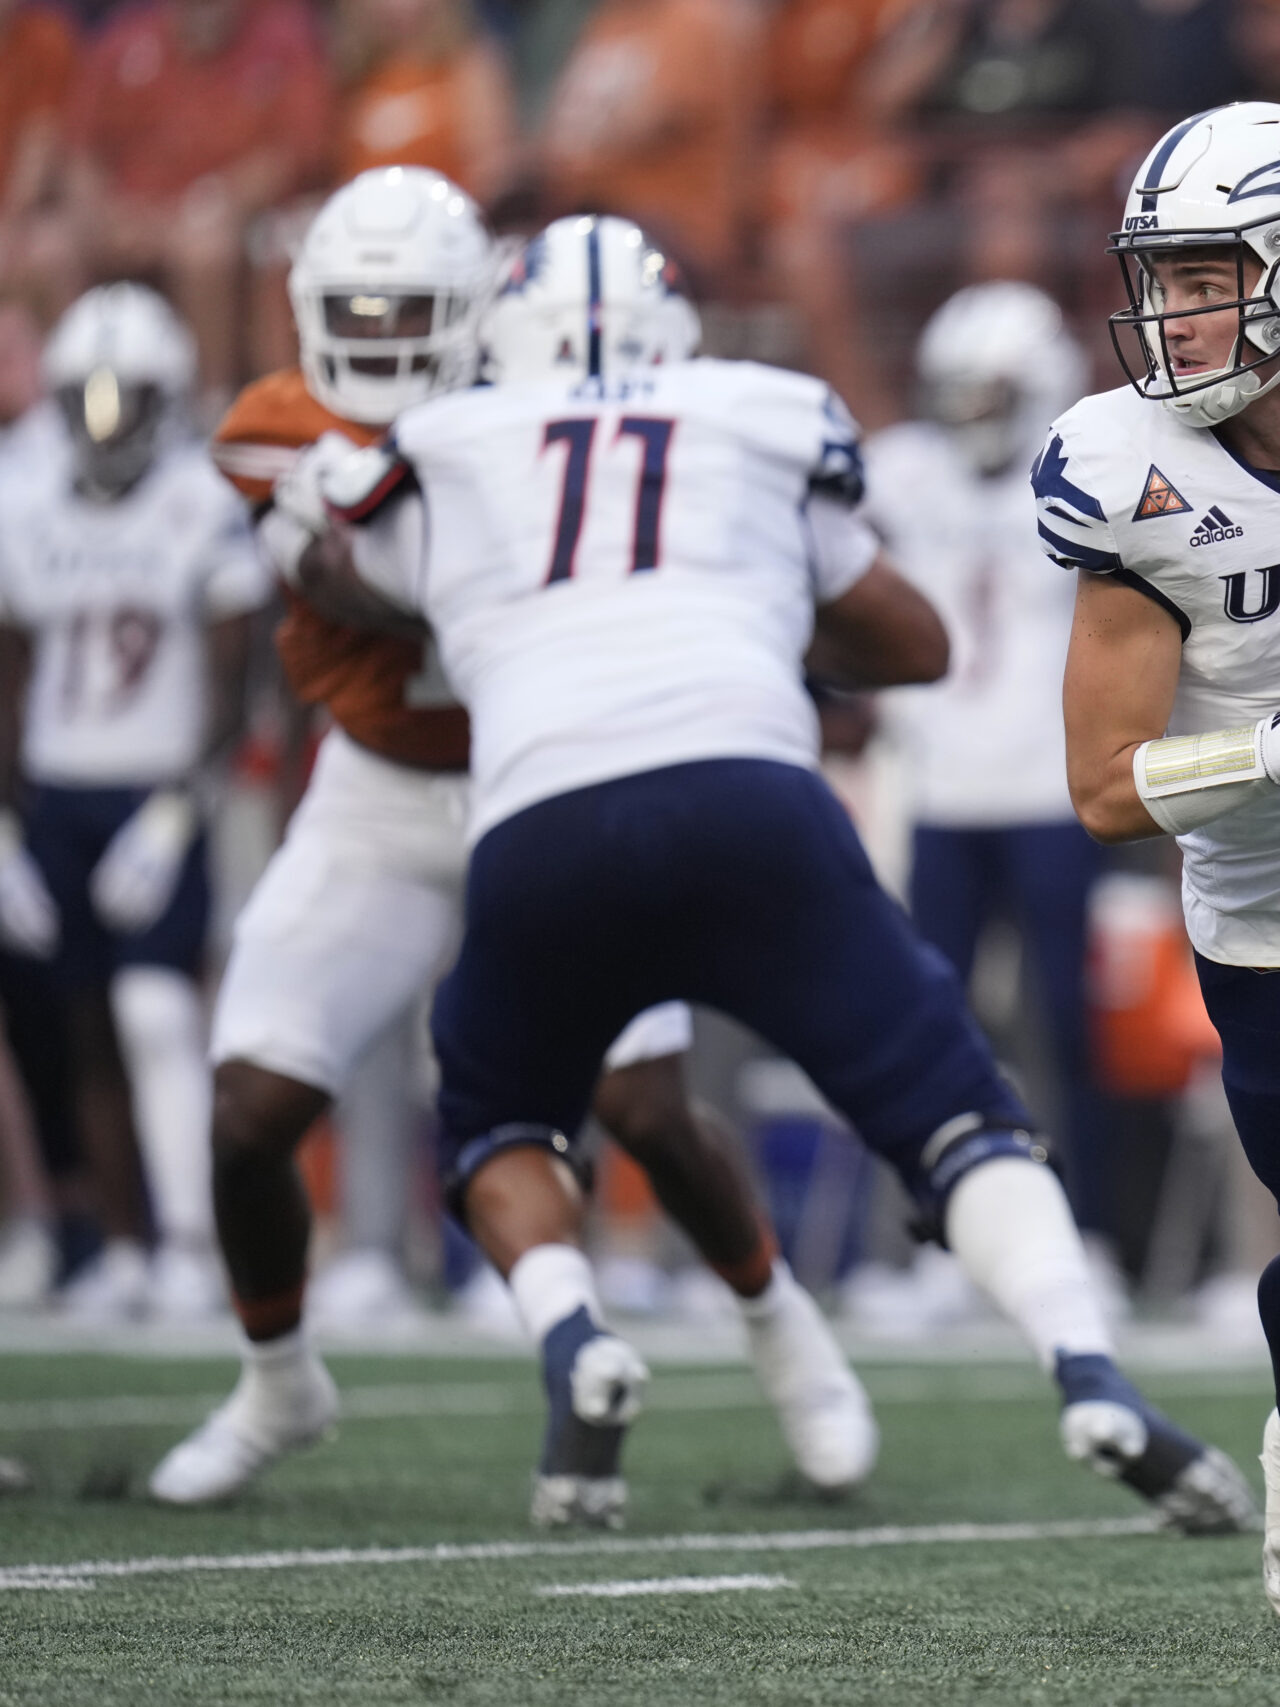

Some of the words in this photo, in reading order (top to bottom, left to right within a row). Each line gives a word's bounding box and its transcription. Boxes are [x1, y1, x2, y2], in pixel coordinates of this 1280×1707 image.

[1125, 215, 1159, 231] UTSA
[538, 416, 678, 589] 11
[1189, 525, 1244, 548] adidas
